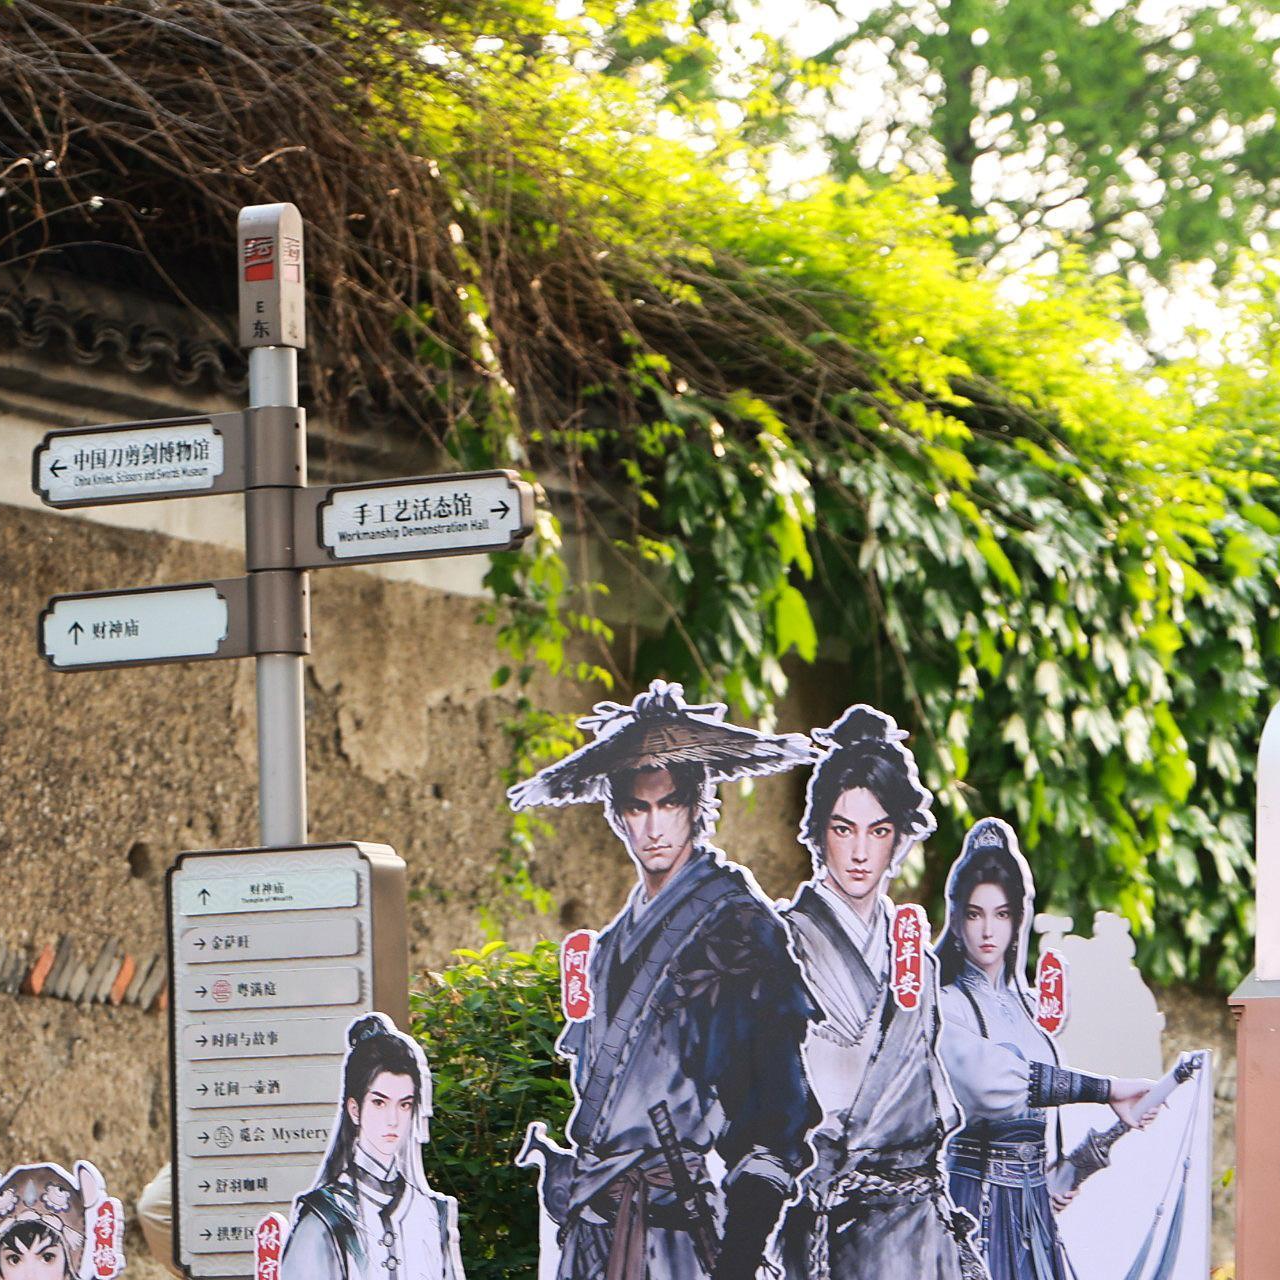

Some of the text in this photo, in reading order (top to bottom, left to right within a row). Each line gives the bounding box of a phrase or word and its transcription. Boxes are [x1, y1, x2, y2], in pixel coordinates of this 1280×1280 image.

[257, 301, 264, 313] E
[252, 320, 270, 338] 东
[74, 438, 210, 471] 中国刀剪剑博物馆
[144, 469, 155, 481] and
[353, 492, 473, 526] 手工艺活态馆
[338, 518, 490, 542] Workmanship Demonstration Hall
[91, 618, 140, 640] 财神庙
[249, 882, 285, 895] 财神庙
[895, 915, 921, 997] 陈平安
[565, 948, 588, 1005] 阿良
[1039, 965, 1063, 1020] 宁姚
[211, 1031, 279, 1047] 时间与故事
[214, 1079, 281, 1096] 花间一壶酒
[272, 1127, 329, 1144] Mystery
[216, 1177, 269, 1193] 舒羽咖啡
[217, 1226, 256, 1242] 拱墅区
